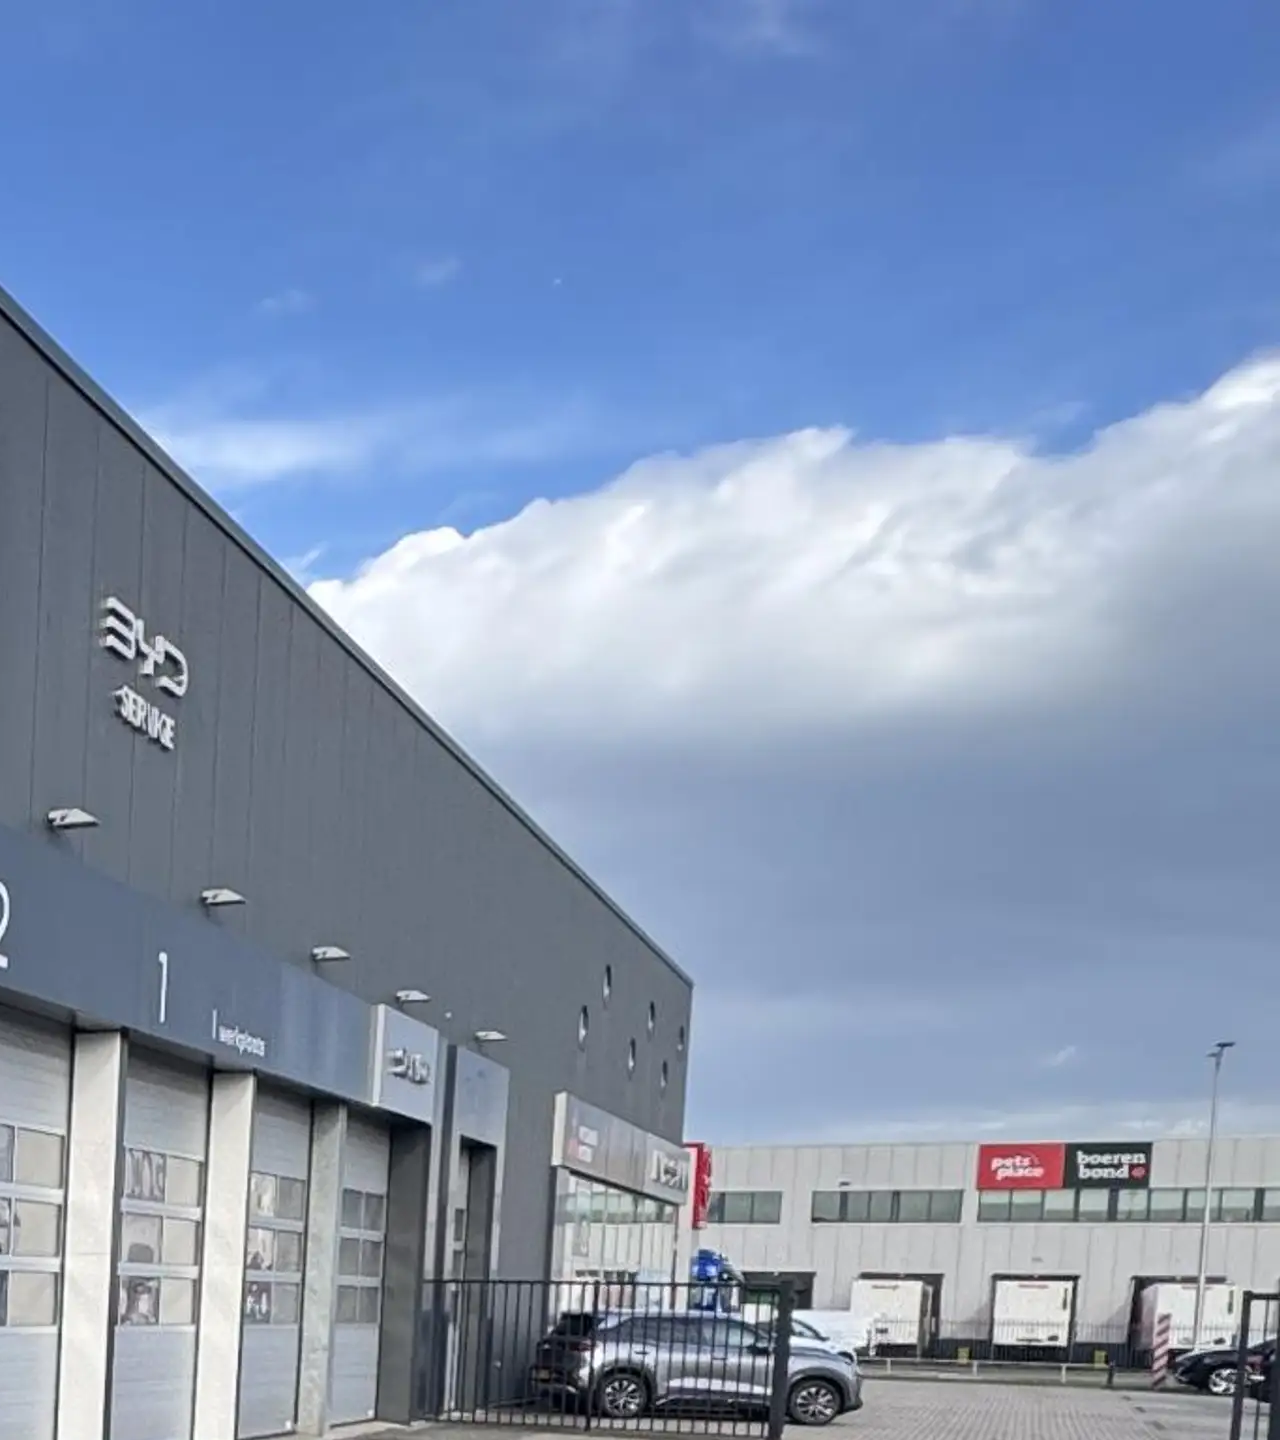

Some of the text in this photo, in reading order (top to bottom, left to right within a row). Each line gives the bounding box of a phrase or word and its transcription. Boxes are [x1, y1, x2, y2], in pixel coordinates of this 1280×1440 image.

[100, 597, 189, 697] BYD
[113, 685, 176, 750] SERVICE
[158, 951, 168, 1023] 1
[991, 1154, 1032, 1171] pets
[1076, 1151, 1146, 1164] boeren
[996, 1164, 1044, 1181] place
[1078, 1164, 1129, 1179] bond
